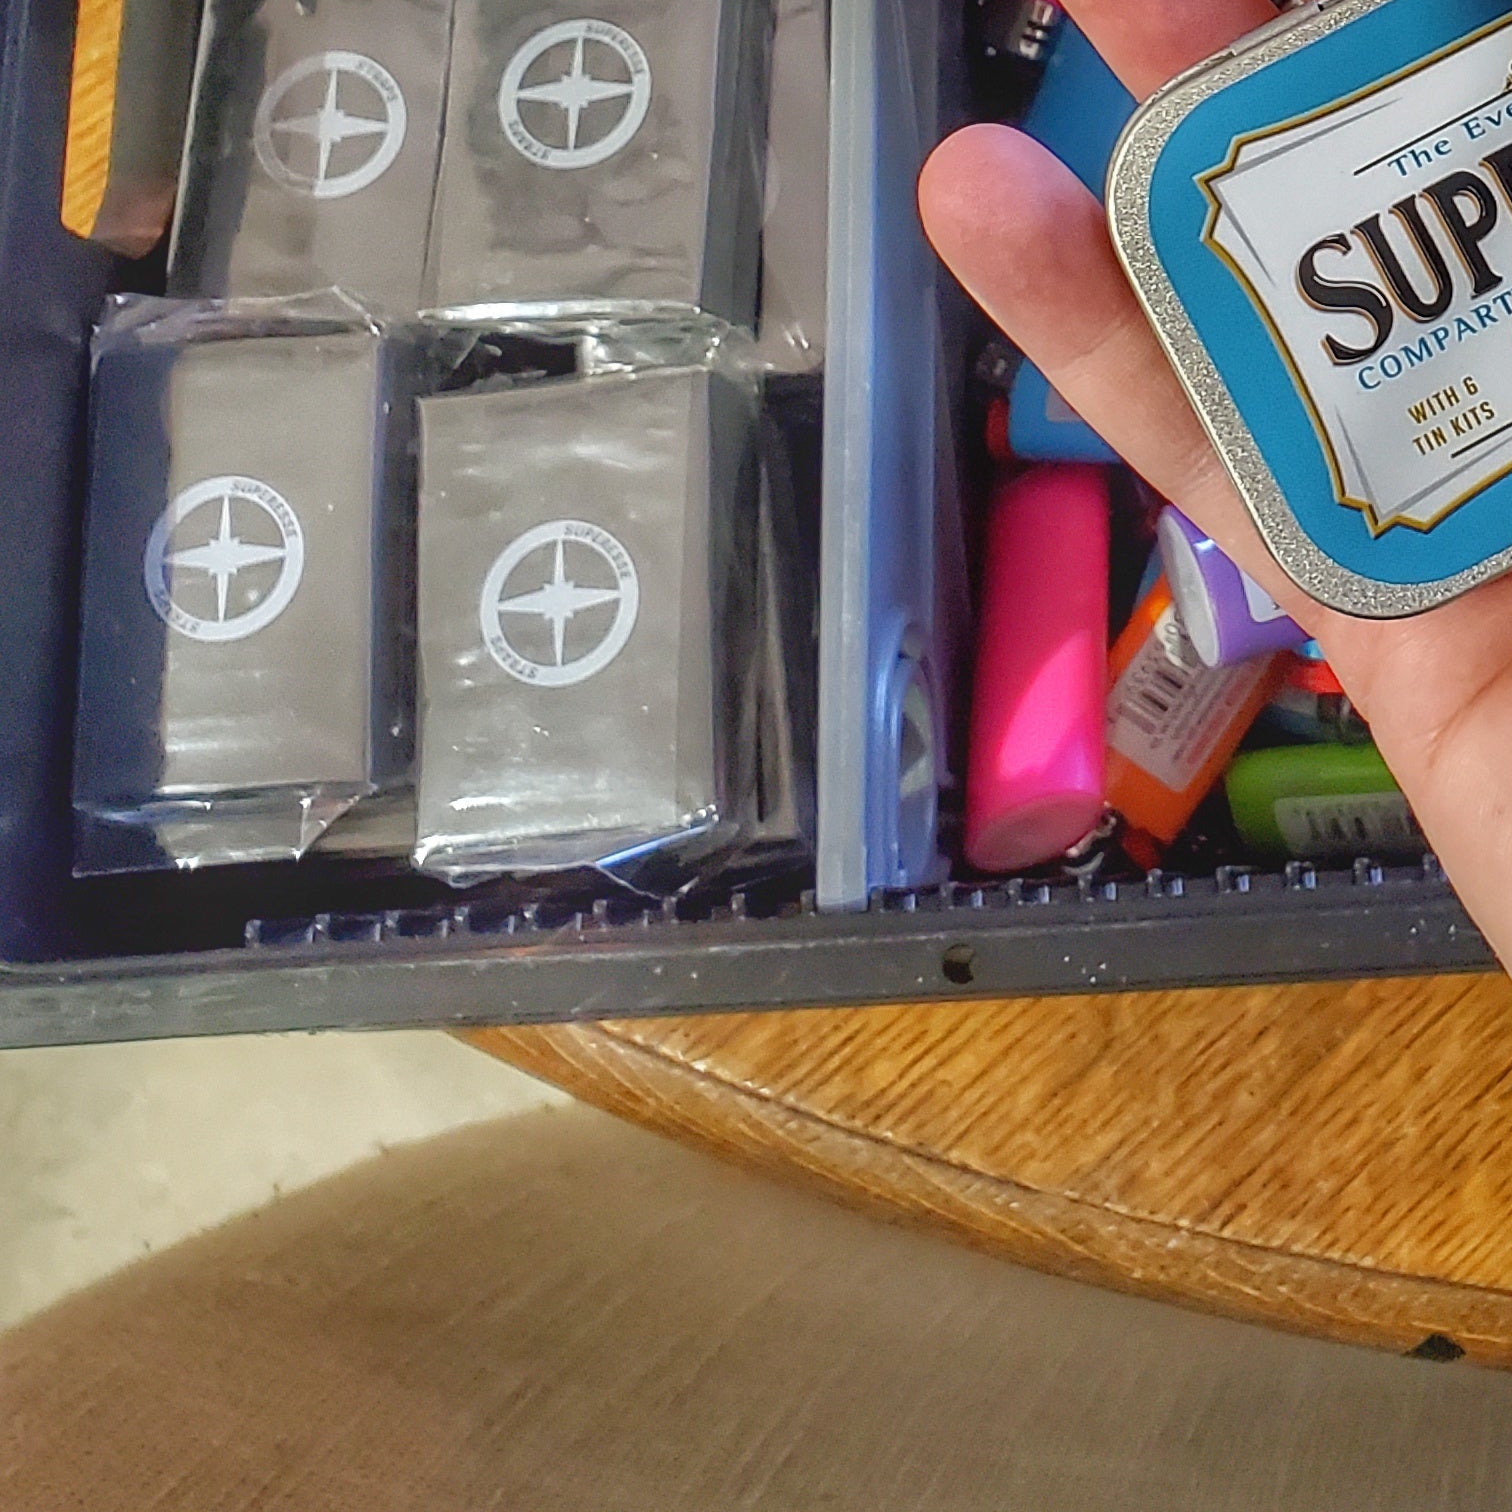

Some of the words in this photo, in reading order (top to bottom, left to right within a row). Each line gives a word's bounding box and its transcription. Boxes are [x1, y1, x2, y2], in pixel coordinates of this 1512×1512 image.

[585, 23, 646, 74] SUPERESSE
[1388, 138, 1453, 177] The
[1407, 386, 1461, 424] WITH
[1465, 376, 1479, 397] 6
[1412, 425, 1449, 457] TIN
[1452, 400, 1496, 437] KITS
[232, 480, 298, 537] SUPERESSE
[563, 522, 632, 579] SUPERESSE
